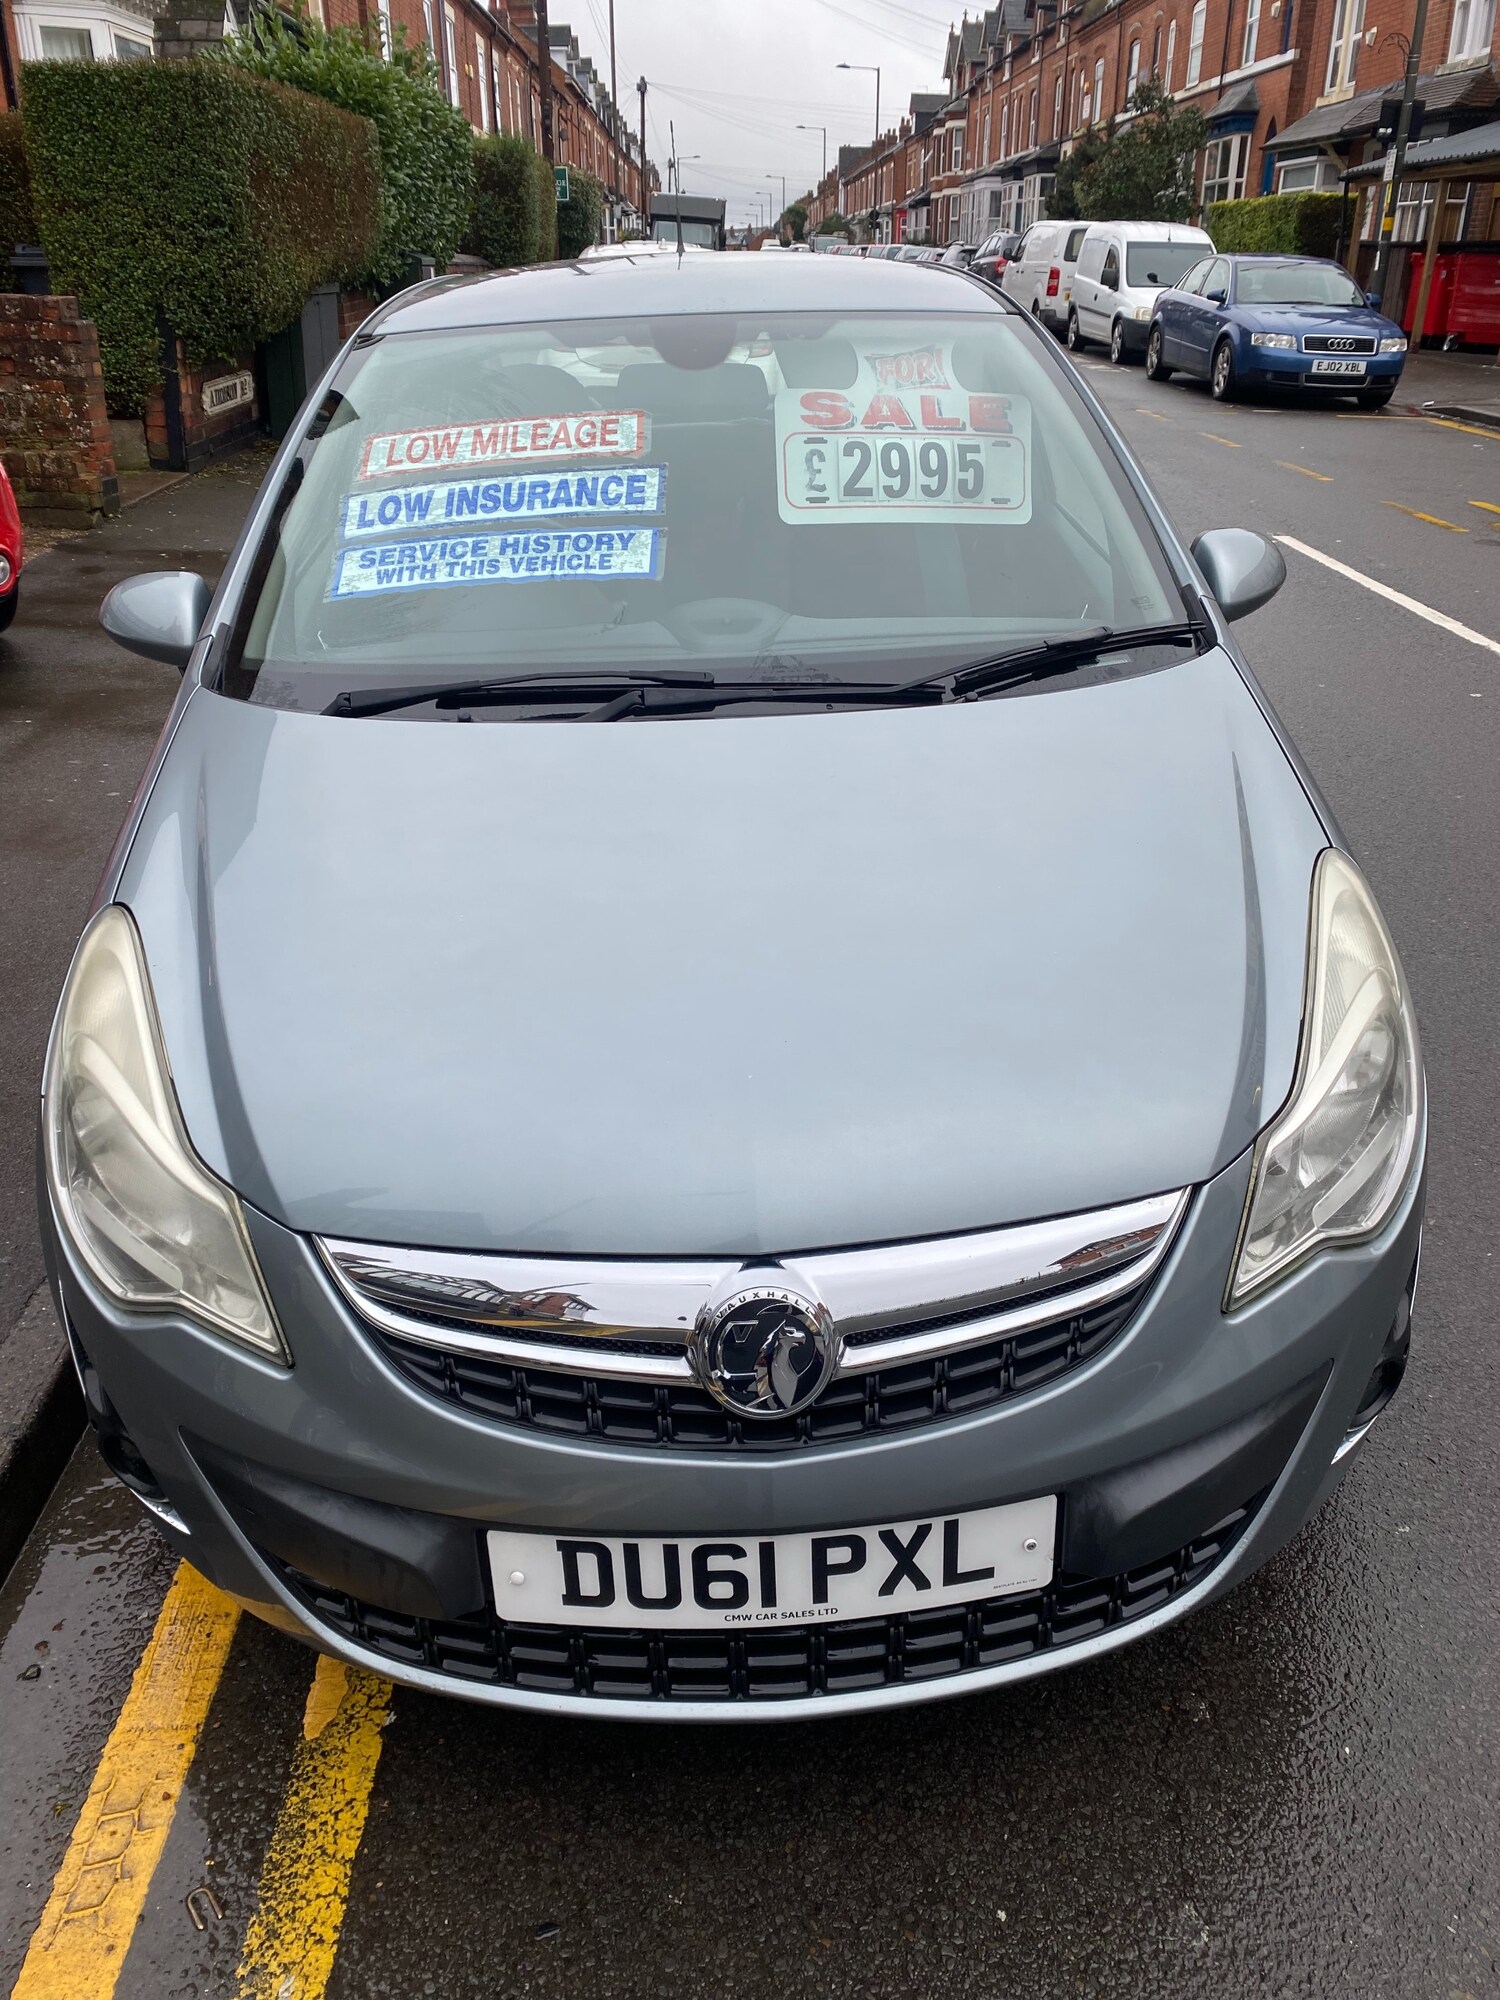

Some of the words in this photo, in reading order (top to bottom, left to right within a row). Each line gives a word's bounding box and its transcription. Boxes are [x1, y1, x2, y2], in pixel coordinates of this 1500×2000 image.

[1317, 361, 1343, 371] EJ02
[1344, 362, 1361, 372] XBL
[800, 391, 1013, 434] SALE
[385, 431, 463, 467] LOW
[470, 418, 621, 457] MILEAGE
[842, 440, 985, 499] 2995
[356, 490, 436, 529] LOW
[445, 474, 648, 518] INSURANCE
[358, 538, 489, 570] SERVICE
[499, 532, 637, 556] HISTORY
[376, 563, 437, 586] WITH
[446, 557, 501, 578] THIS
[510, 553, 613, 574] VEHICLE
[716, 1291, 813, 1320] VAUXHALL
[555, 1538, 778, 1611] DU61
[811, 1518, 995, 1606] PXL
[724, 1614, 753, 1622] CMW
[755, 1612, 778, 1621] CAR
[781, 1609, 815, 1620] SALES
[818, 1607, 838, 1617] LTD
